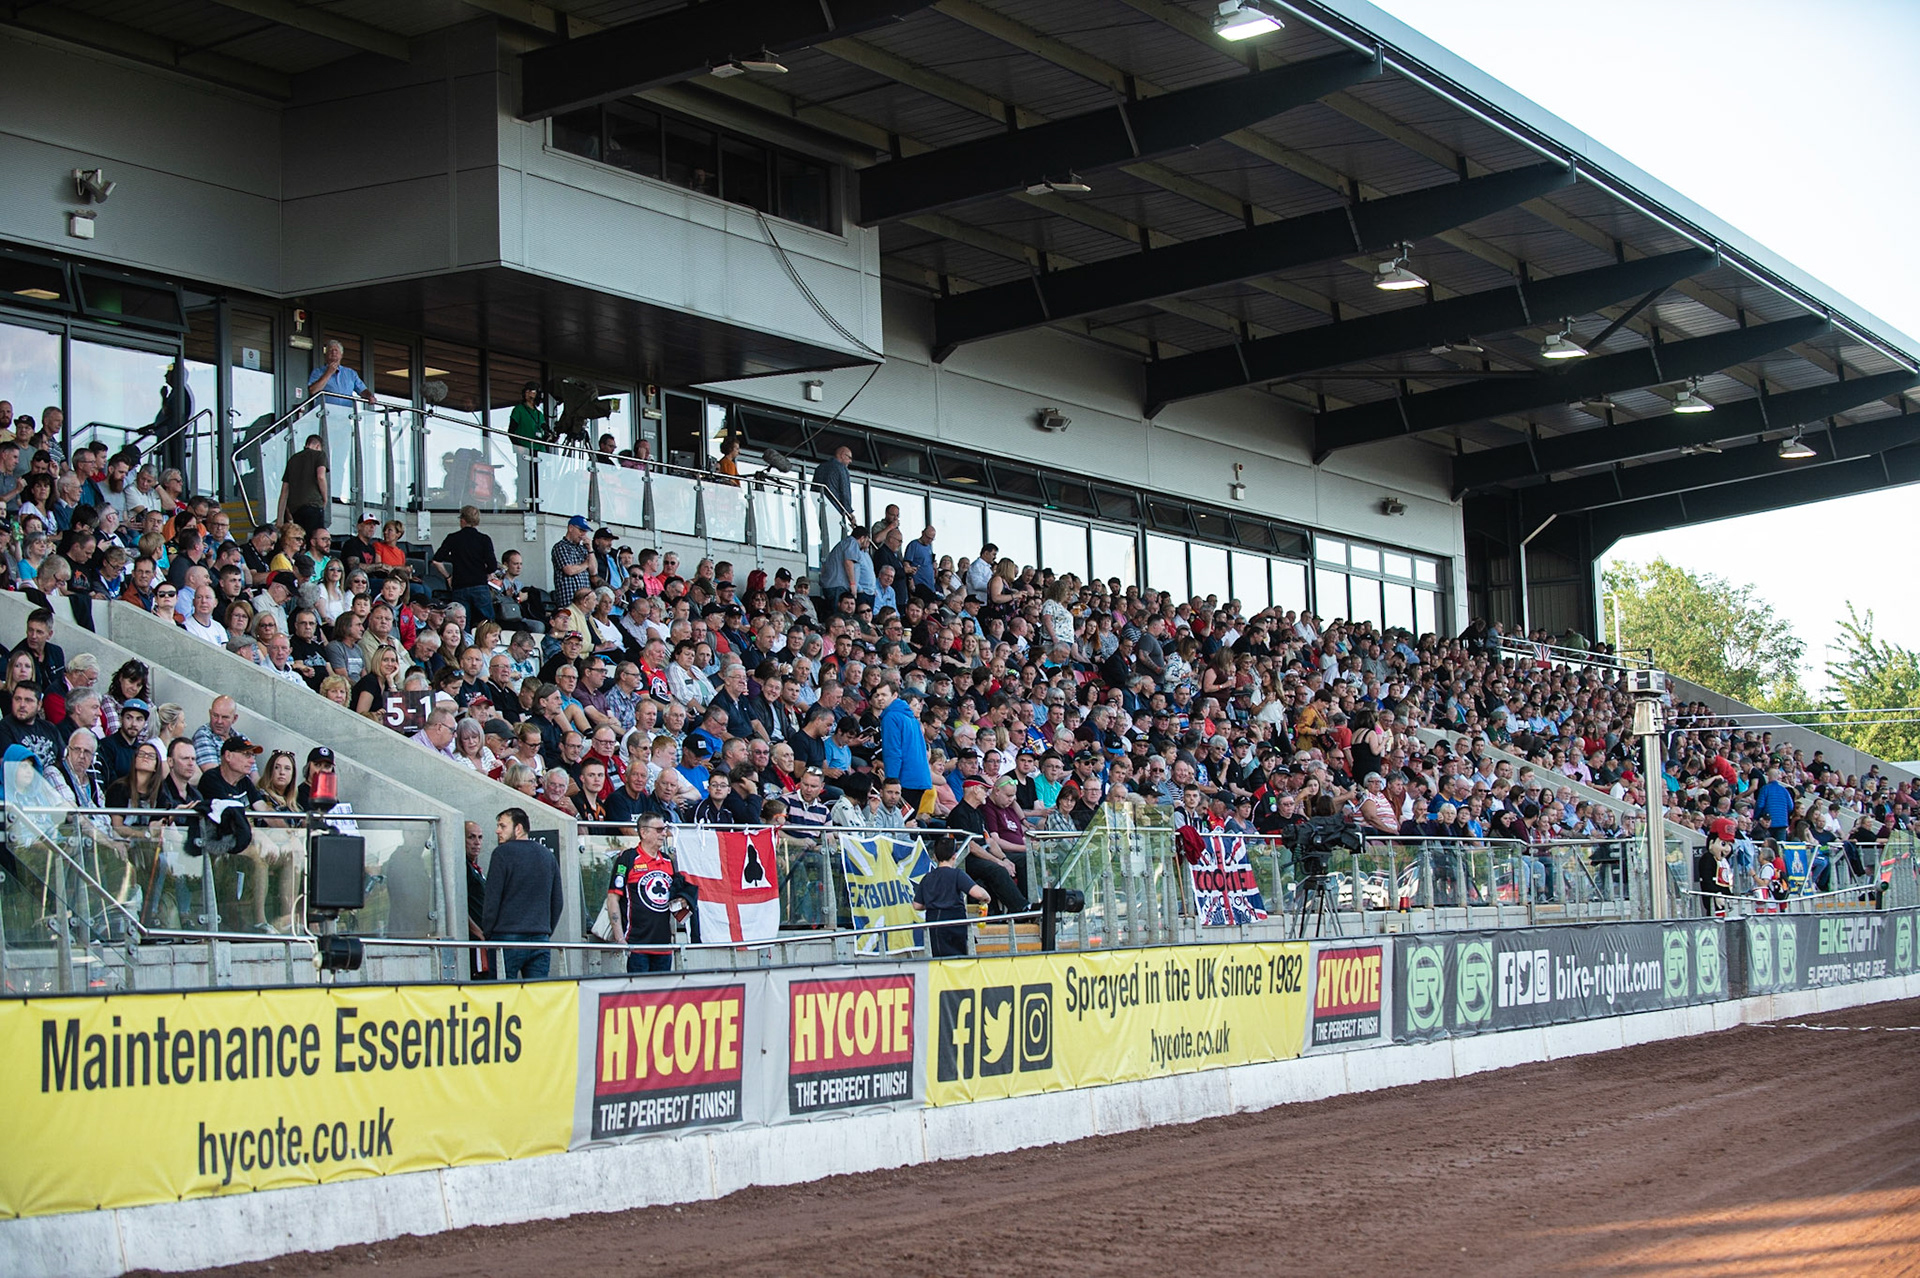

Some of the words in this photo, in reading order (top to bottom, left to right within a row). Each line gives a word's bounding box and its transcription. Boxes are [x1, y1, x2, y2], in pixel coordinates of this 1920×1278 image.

[1065, 966, 1139, 1021] Sprayed
[1145, 961, 1160, 1004] in
[1165, 960, 1190, 1003] the
[1196, 958, 1217, 1000] UK
[1222, 956, 1262, 996] since
[1267, 954, 1302, 994] 1982
[1316, 955, 1380, 1009] HYCOTE
[1556, 952, 1661, 1004] bike-right.com
[41, 1014, 320, 1093] Maintenance
[334, 1002, 523, 1073] Essentials
[602, 999, 739, 1082] HYCOTE
[794, 987, 909, 1062] HYCOTE
[1150, 1020, 1230, 1069] hycote.co.uk
[1315, 1022, 1328, 1041] THE
[1328, 1018, 1356, 1039] PERFECT
[1356, 1016, 1378, 1035] FINISH
[600, 1104, 627, 1132] THE
[628, 1096, 689, 1127] PERFECT
[690, 1090, 735, 1119] FINISH
[795, 1082, 819, 1107] THE
[820, 1075, 871, 1104] PERFECT
[873, 1071, 907, 1098] FINISH
[198, 1106, 394, 1186] hycote.co.uk
